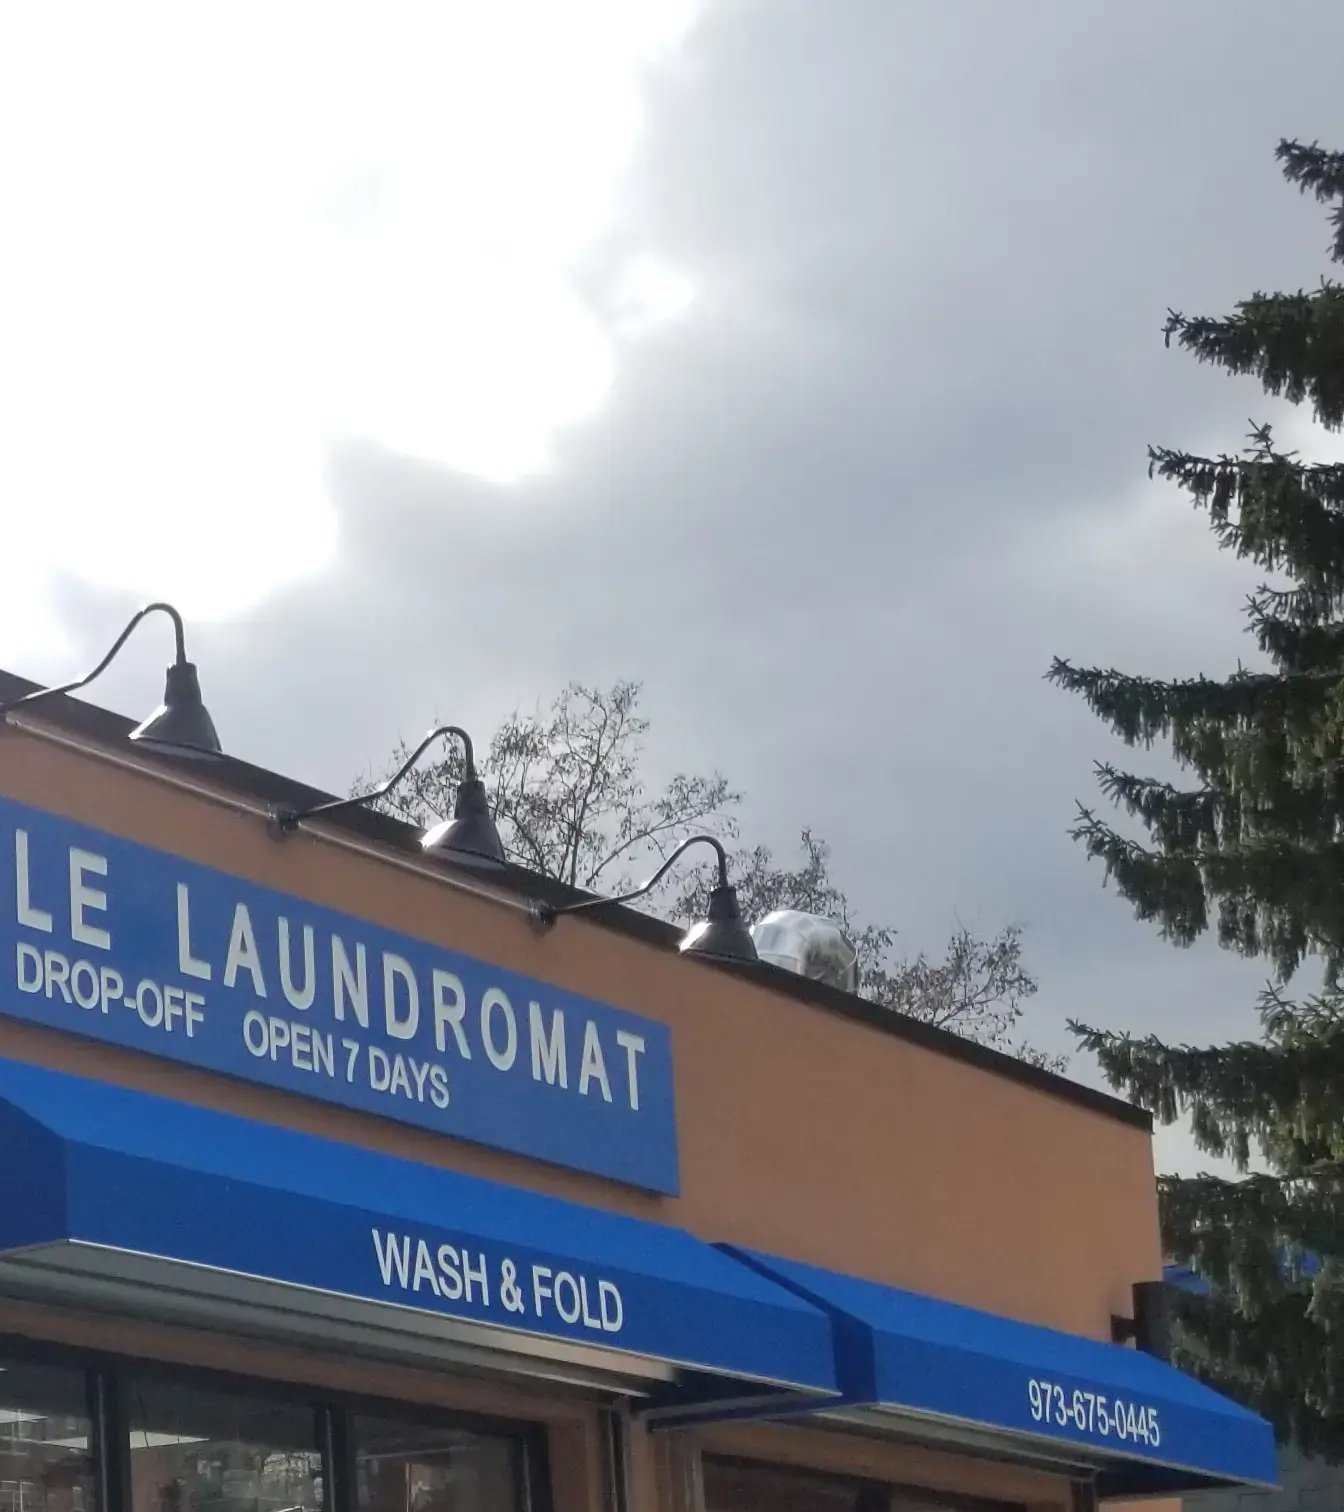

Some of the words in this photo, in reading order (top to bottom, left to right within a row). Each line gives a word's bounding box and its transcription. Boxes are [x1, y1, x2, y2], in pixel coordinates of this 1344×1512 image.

[17, 942, 205, 1037] DROP-OFF
[243, 1010, 335, 1077] OPEN
[342, 1038, 361, 1083] 7
[369, 1046, 450, 1109] DAYS
[176, 882, 645, 1111] LAUNDROMAT
[371, 1228, 490, 1307] WASH
[500, 1258, 525, 1314] &
[532, 1265, 624, 1332] FOLD
[1028, 1379, 1161, 1447] 973-675-0445
